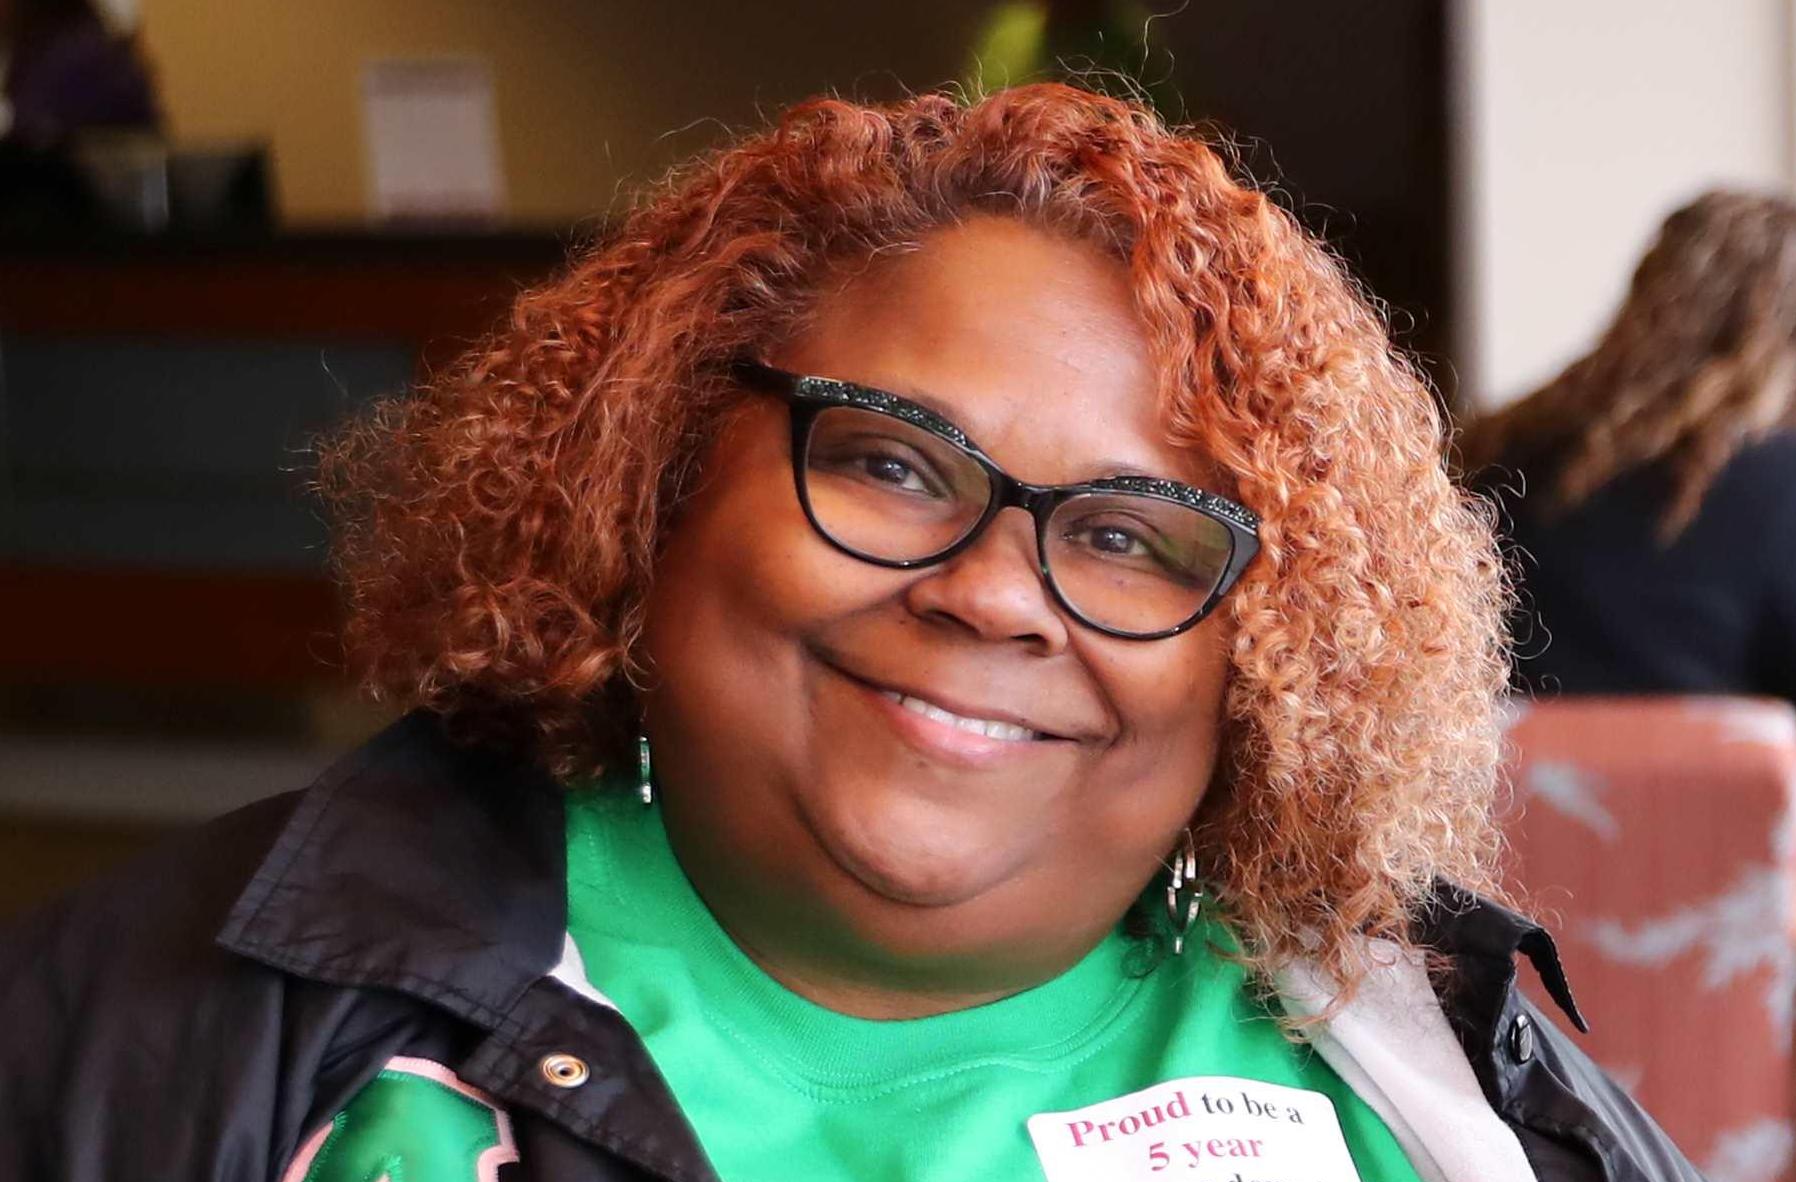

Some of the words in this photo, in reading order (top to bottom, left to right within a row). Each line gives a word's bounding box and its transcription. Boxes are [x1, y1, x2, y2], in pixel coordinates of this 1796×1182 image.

[1067, 1090, 1192, 1148] Proud
[1201, 1092, 1234, 1115] to
[1244, 1092, 1278, 1120] be
[1287, 1105, 1303, 1125] a
[1148, 1142, 1171, 1171] 5
[1183, 1136, 1264, 1168] year
